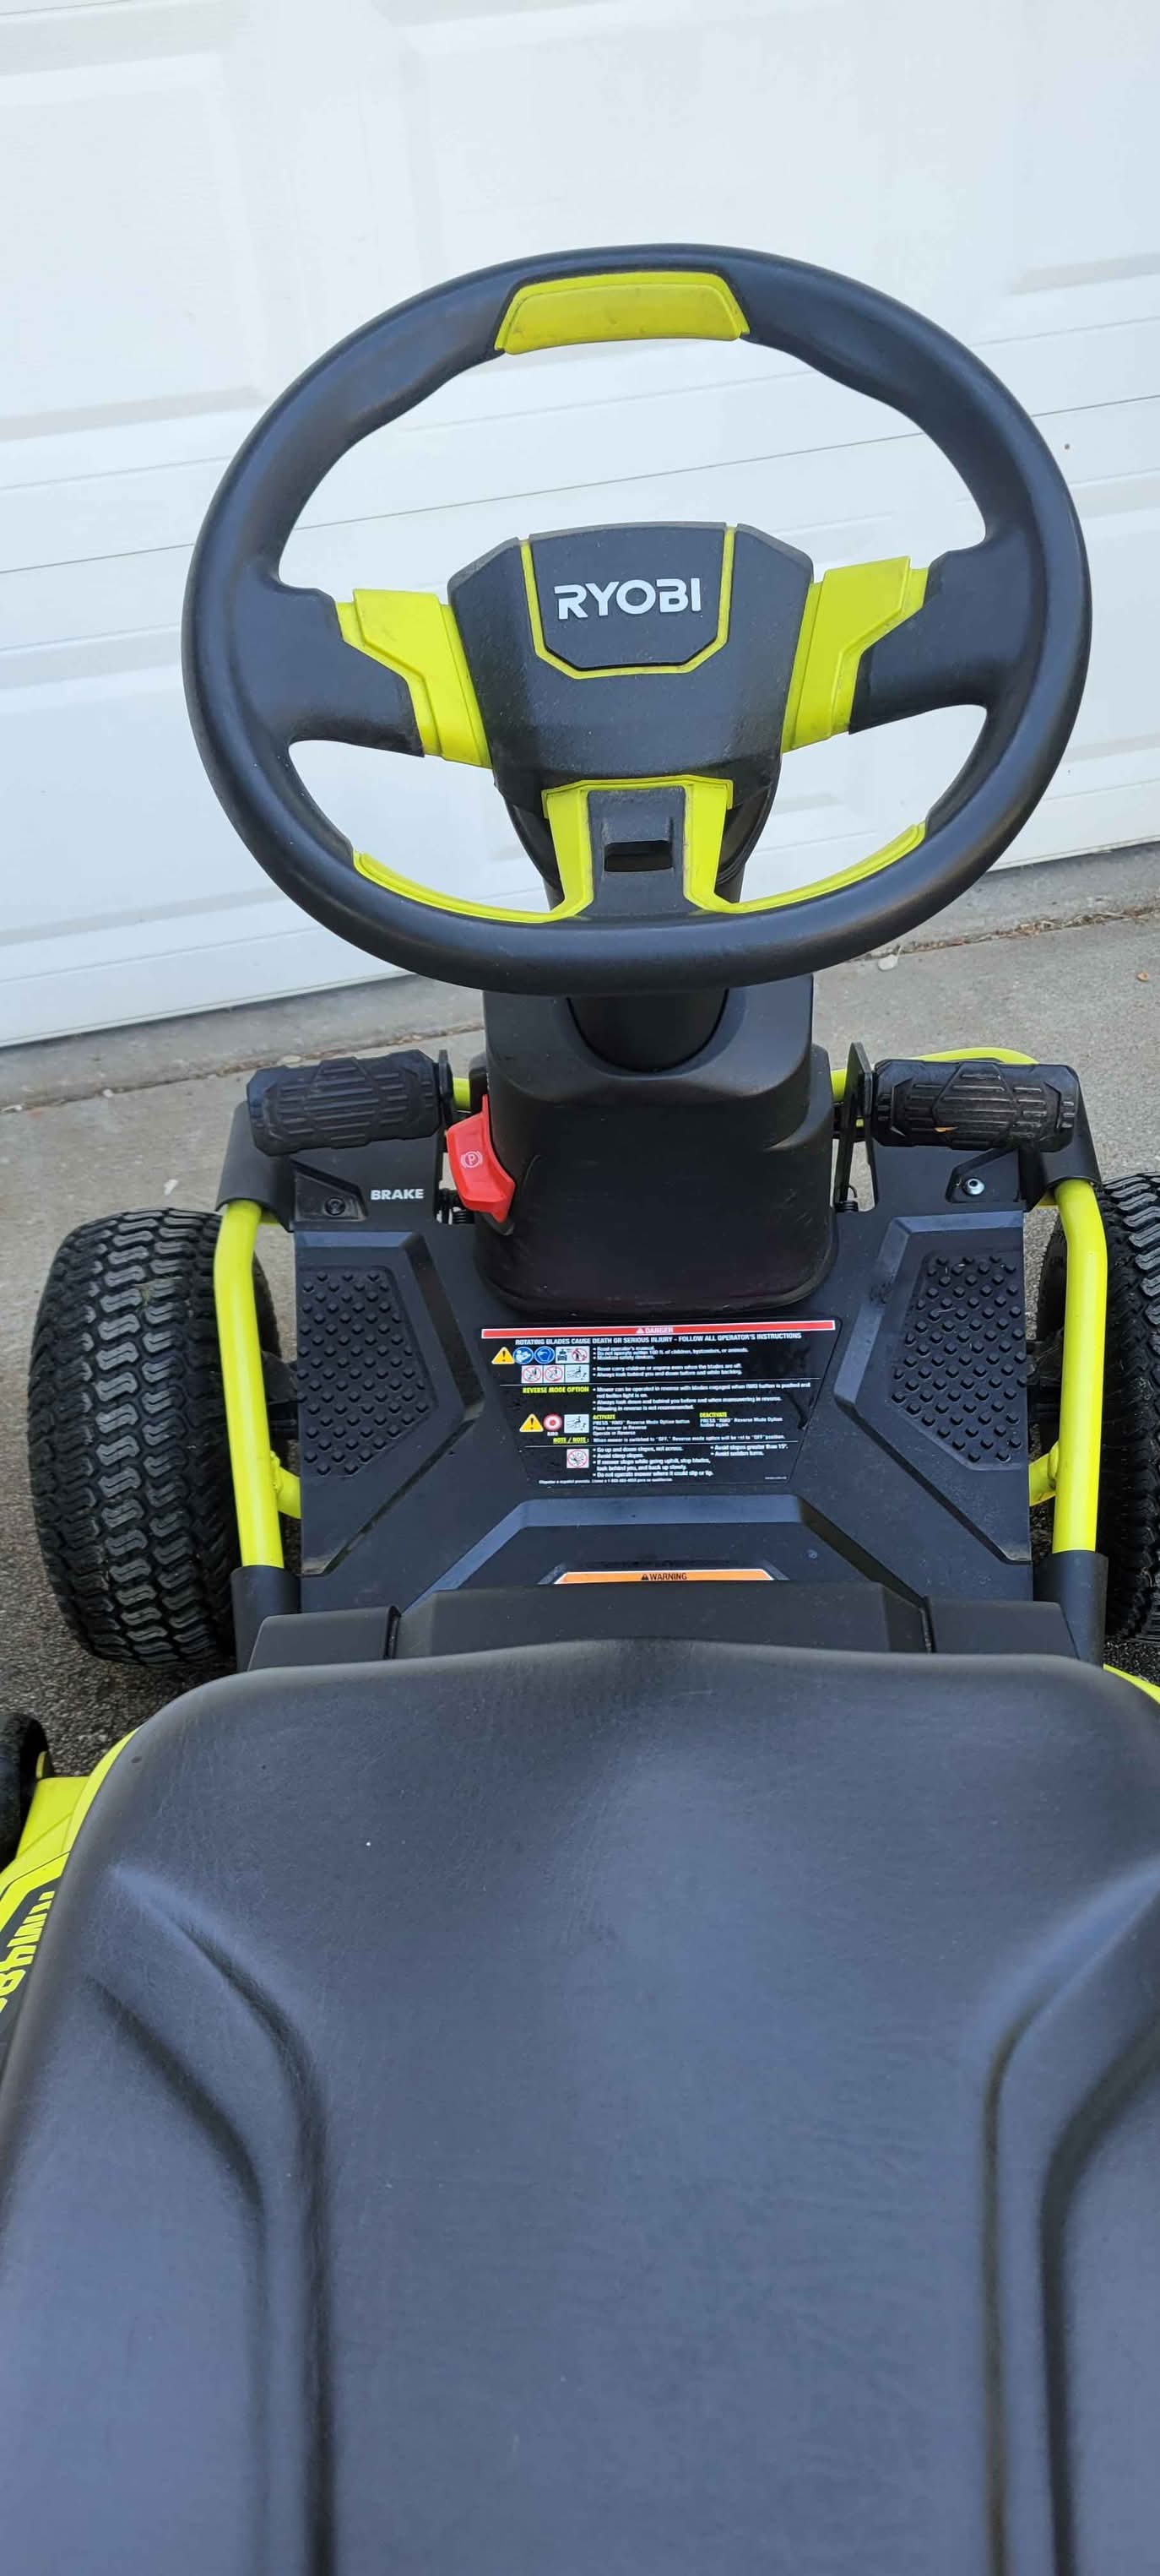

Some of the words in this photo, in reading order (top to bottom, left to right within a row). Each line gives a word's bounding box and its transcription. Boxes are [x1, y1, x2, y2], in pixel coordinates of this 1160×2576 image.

[554, 578, 702, 620] RYOBI
[468, 1153, 476, 1164] P
[371, 1189, 424, 1200] BRAKE
[650, 1572, 687, 1581] WARNING
